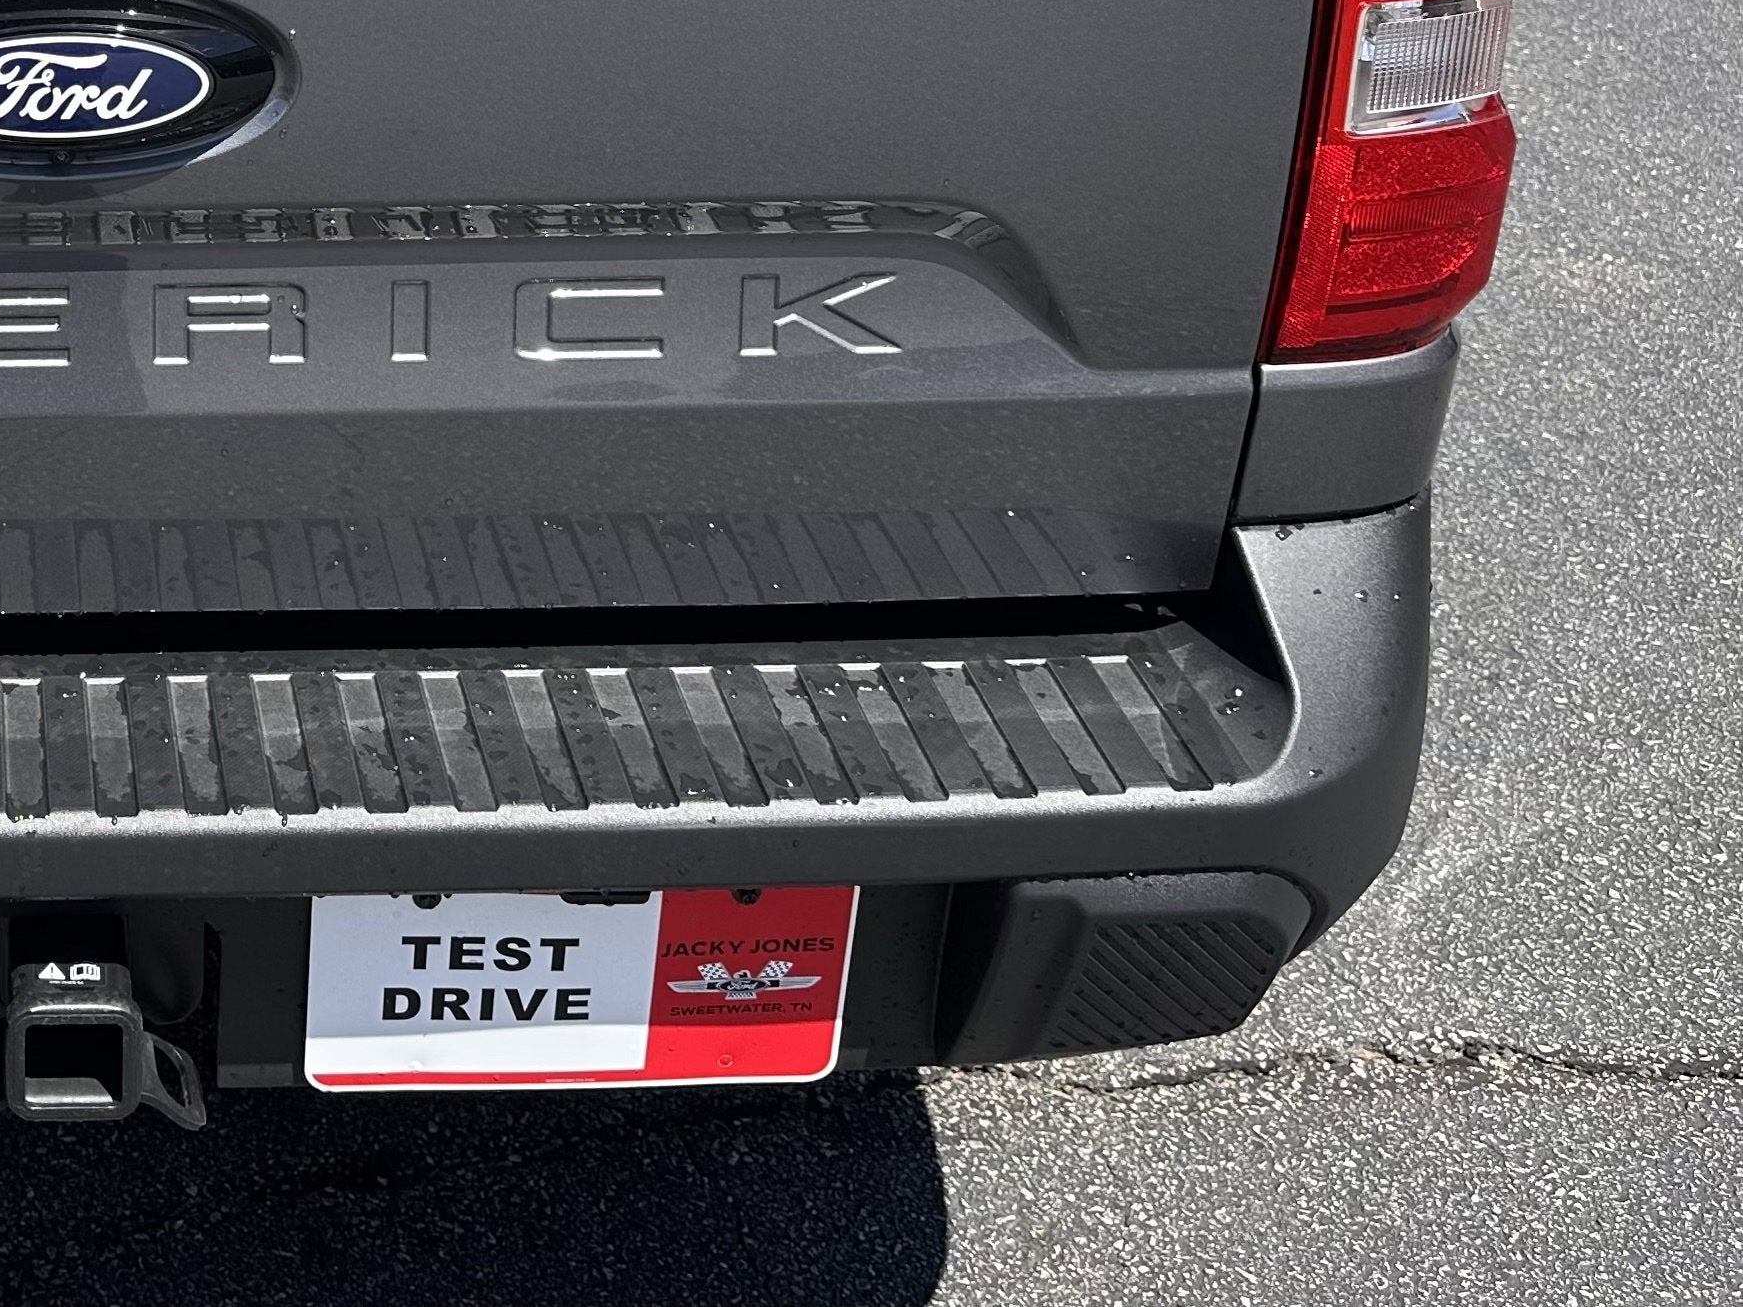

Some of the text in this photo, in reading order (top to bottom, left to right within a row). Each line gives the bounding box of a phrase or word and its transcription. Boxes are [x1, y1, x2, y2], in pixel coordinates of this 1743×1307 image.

[401, 936, 580, 972] TEST
[661, 937, 835, 958] JACKY JONES
[382, 987, 591, 1021] DRIVE
[790, 1002, 813, 1012] TN
